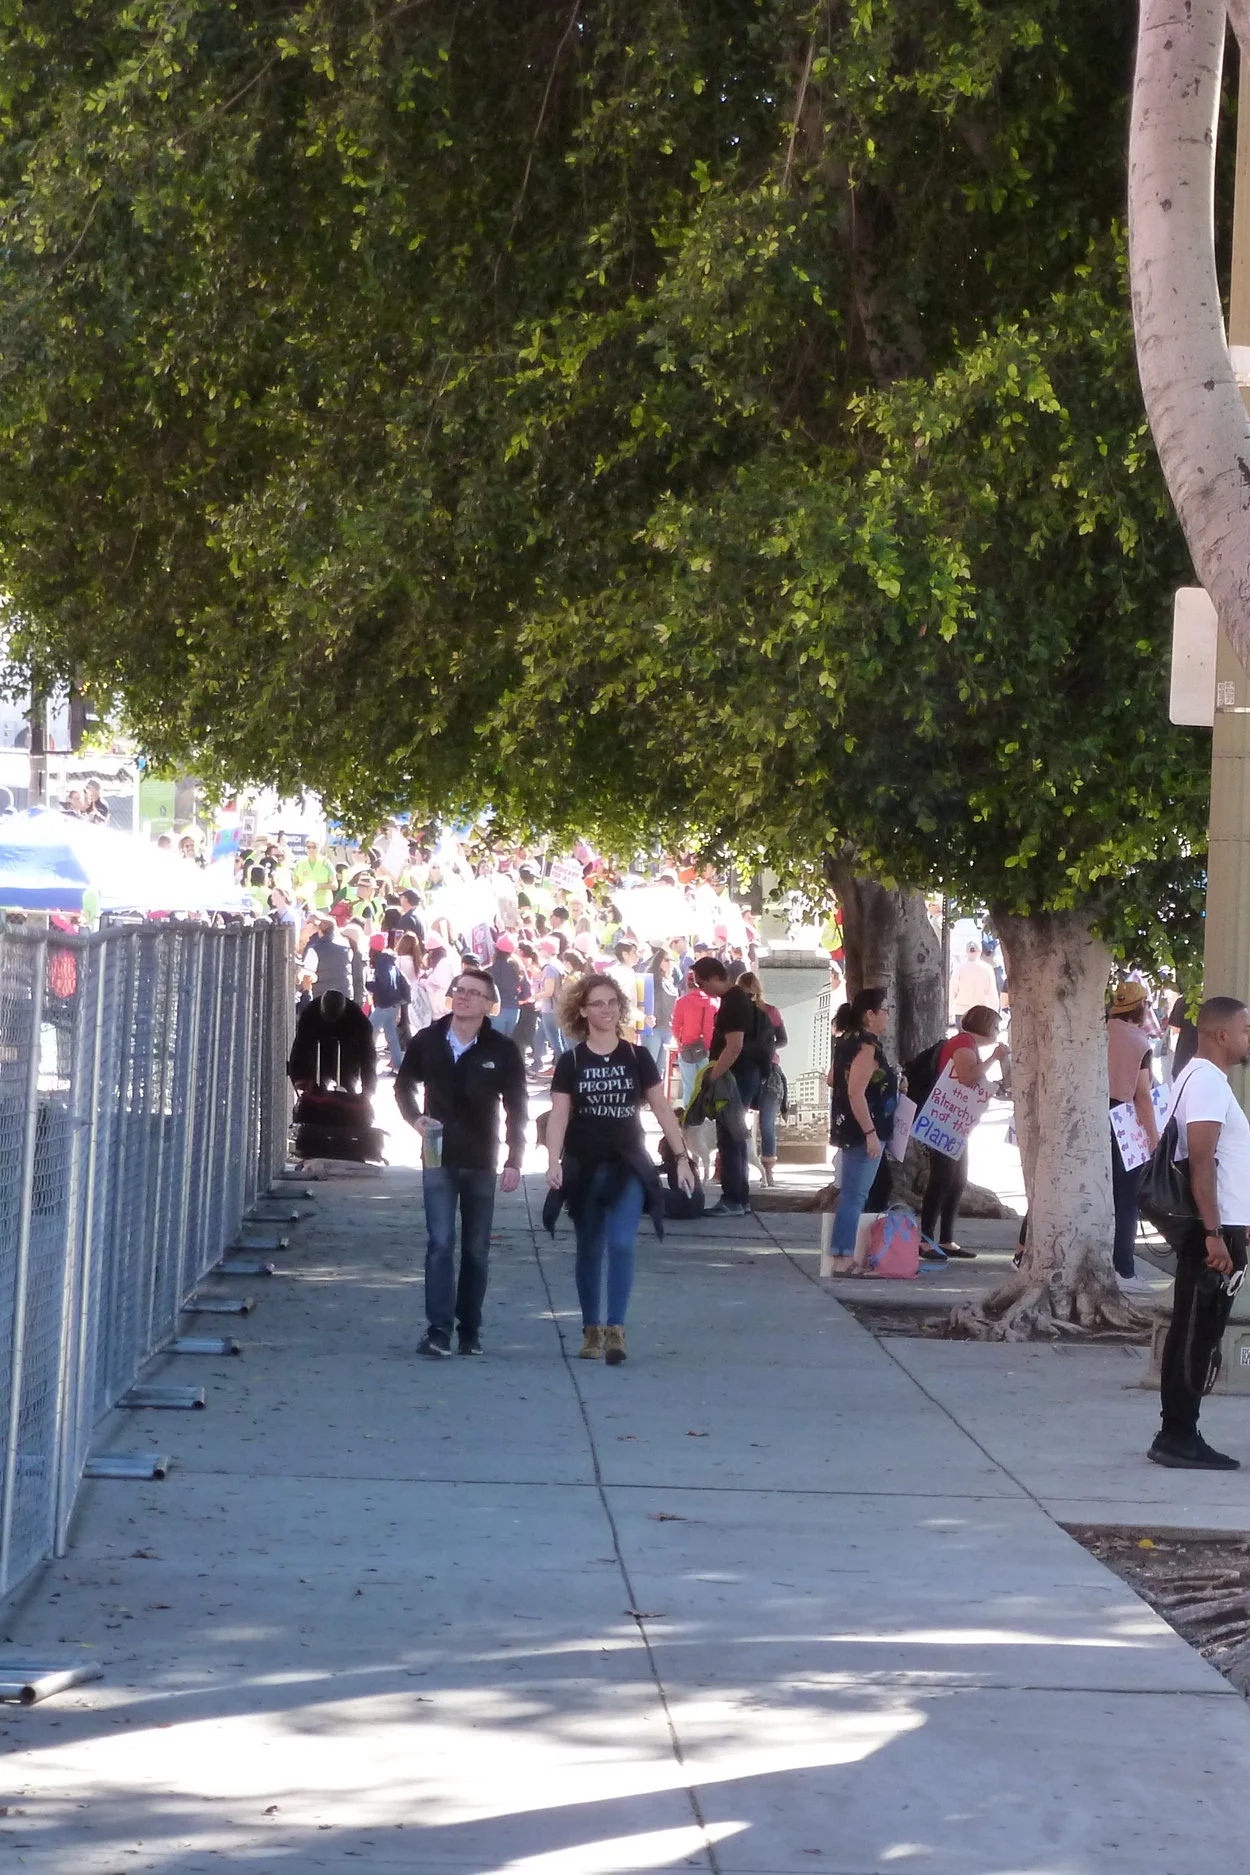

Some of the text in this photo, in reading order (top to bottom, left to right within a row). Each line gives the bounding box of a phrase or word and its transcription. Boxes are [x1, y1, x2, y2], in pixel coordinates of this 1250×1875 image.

[584, 1065, 626, 1079] TREAT
[579, 1078, 634, 1093] PEOPLE
[586, 1093, 627, 1104] WITH
[952, 1087, 969, 1103] the
[931, 1087, 977, 1126] Patriarchy
[930, 1108, 970, 1136] not the
[914, 1115, 964, 1156] Planet
